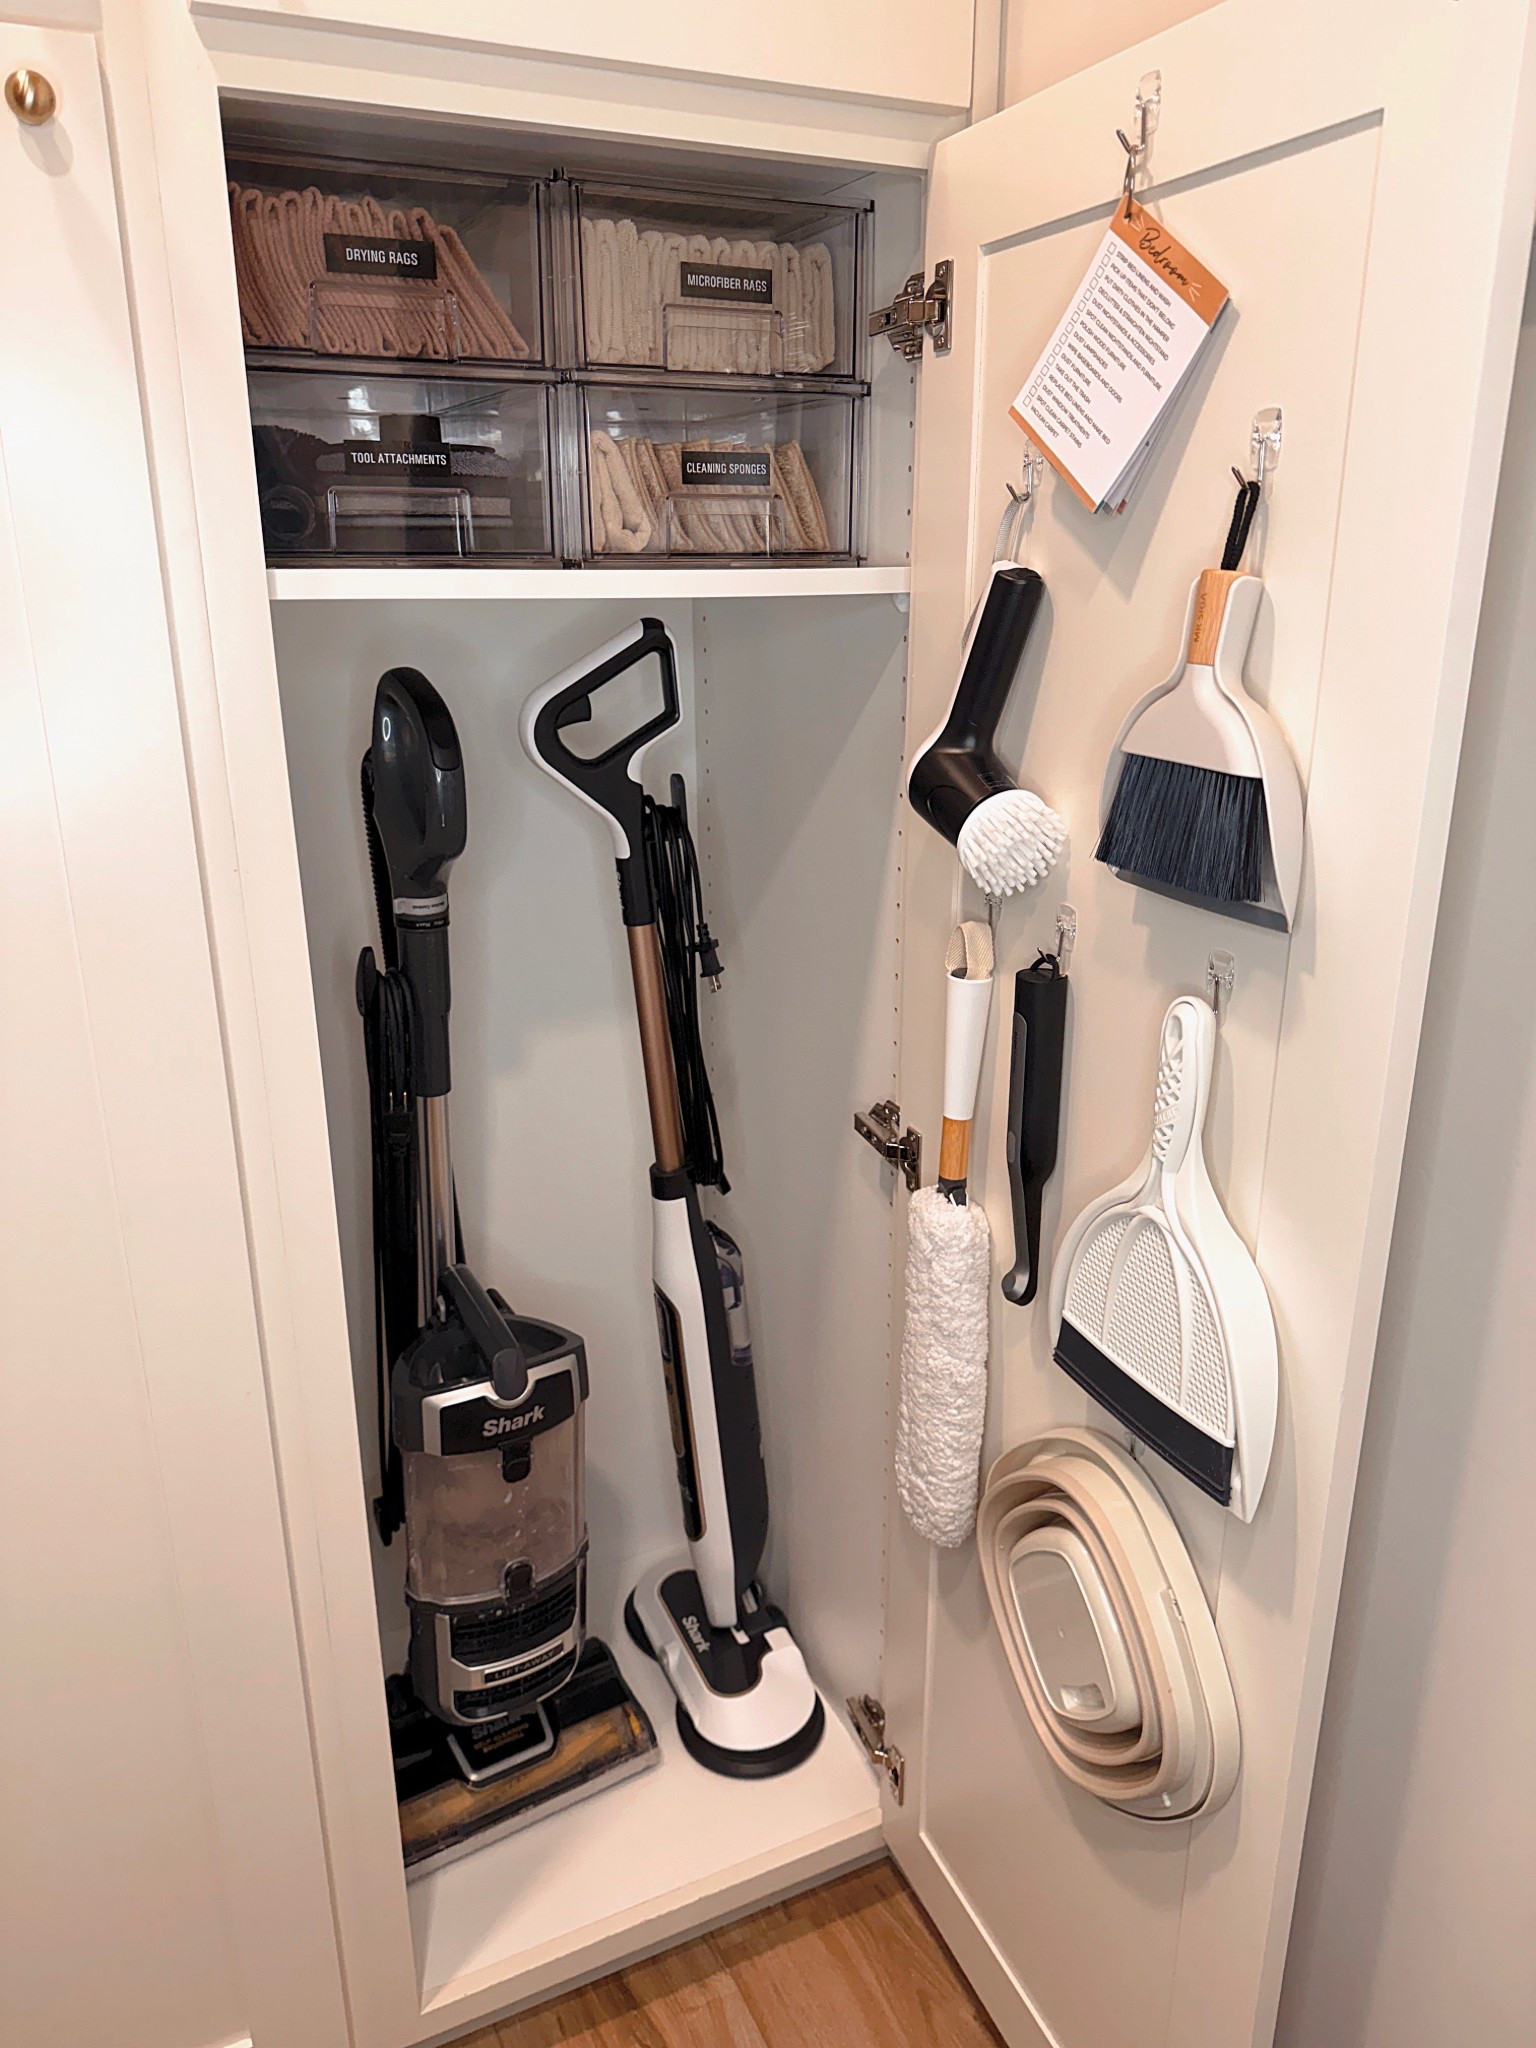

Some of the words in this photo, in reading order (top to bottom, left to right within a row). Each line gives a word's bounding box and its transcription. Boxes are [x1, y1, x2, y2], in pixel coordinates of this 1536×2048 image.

[345, 248, 386, 263] DRYING
[389, 251, 418, 266] RAGS
[1116, 251, 1128, 264] STRIP
[1127, 261, 1136, 273] BED
[1135, 270, 1150, 286] LINENS
[1149, 283, 1159, 295] AND
[1158, 292, 1171, 307] WASH
[1139, 227, 1189, 286] Bedroom
[687, 274, 741, 290] MICROFIBER
[743, 279, 767, 292] RAGS
[1104, 274, 1112, 285] PUT
[1112, 282, 1123, 296] DIRTY
[1123, 293, 1141, 313] CLOTHES
[1144, 315, 1153, 325] THE
[1152, 323, 1169, 342] HAMPER
[1110, 263, 1120, 275] PICK
[1125, 277, 1137, 292] ITEMS
[1136, 289, 1147, 301] THAT
[1146, 298, 1159, 313] DON'T
[1158, 310, 1175, 329] BELONG
[1079, 320, 1093, 337] POLISH
[1093, 334, 1106, 350] WOOD
[1105, 347, 1125, 370] FURNITURE
[1085, 309, 1096, 322] SPOT
[1095, 319, 1108, 335] CLEAN
[1107, 331, 1133, 360] NIGHTSTANDS
[1132, 357, 1141, 369] AND
[1140, 366, 1162, 390] FURNITURE
[1092, 297, 1102, 311] DUST
[1101, 308, 1127, 337] NIGHTSTANDS
[1130, 337, 1155, 365] ACCESSORIES
[1098, 286, 1120, 310] DECLUTTER
[1122, 310, 1145, 337] STRAIGHTEN
[1144, 333, 1169, 361] NIGHTSTAND
[1061, 352, 1071, 365] DUST
[1070, 363, 1090, 386] FURNITURE
[1067, 342, 1077, 355] WIPE
[1077, 352, 1101, 380] BASEBOARDS
[1100, 377, 1109, 389] AND
[1108, 386, 1122, 403] DOORS
[1073, 331, 1084, 344] DUST
[1083, 341, 1107, 369] LAMPSHADES
[1048, 373, 1064, 393] REPLACE
[1064, 390, 1072, 402] BED
[1071, 399, 1084, 416] LINENS
[1083, 413, 1092, 424] AND
[1091, 421, 1102, 436] MAKE
[1102, 433, 1110, 445] BED
[1055, 363, 1064, 375] TAKE
[1064, 373, 1072, 384] OUT
[1071, 381, 1079, 392] THE
[1078, 389, 1090, 404] TRASH
[1030, 405, 1045, 423] VACUUM
[1044, 421, 1058, 438] CARPET
[1036, 394, 1045, 407] SPOT
[1045, 404, 1057, 420] CLEAN
[1056, 417, 1070, 434] CARPET
[1069, 432, 1082, 448] STAINS
[1042, 384, 1052, 397] DUST
[1051, 394, 1068, 415] WINDOW
[1067, 412, 1089, 439] TREATMENTS
[351, 452, 376, 463] TOOL
[378, 453, 447, 465] ATTACHMENTS
[686, 462, 727, 474] CLEANING
[728, 463, 767, 475] SPONGES
[482, 1405, 546, 1437] Shark
[681, 1615, 711, 1653] Shark
